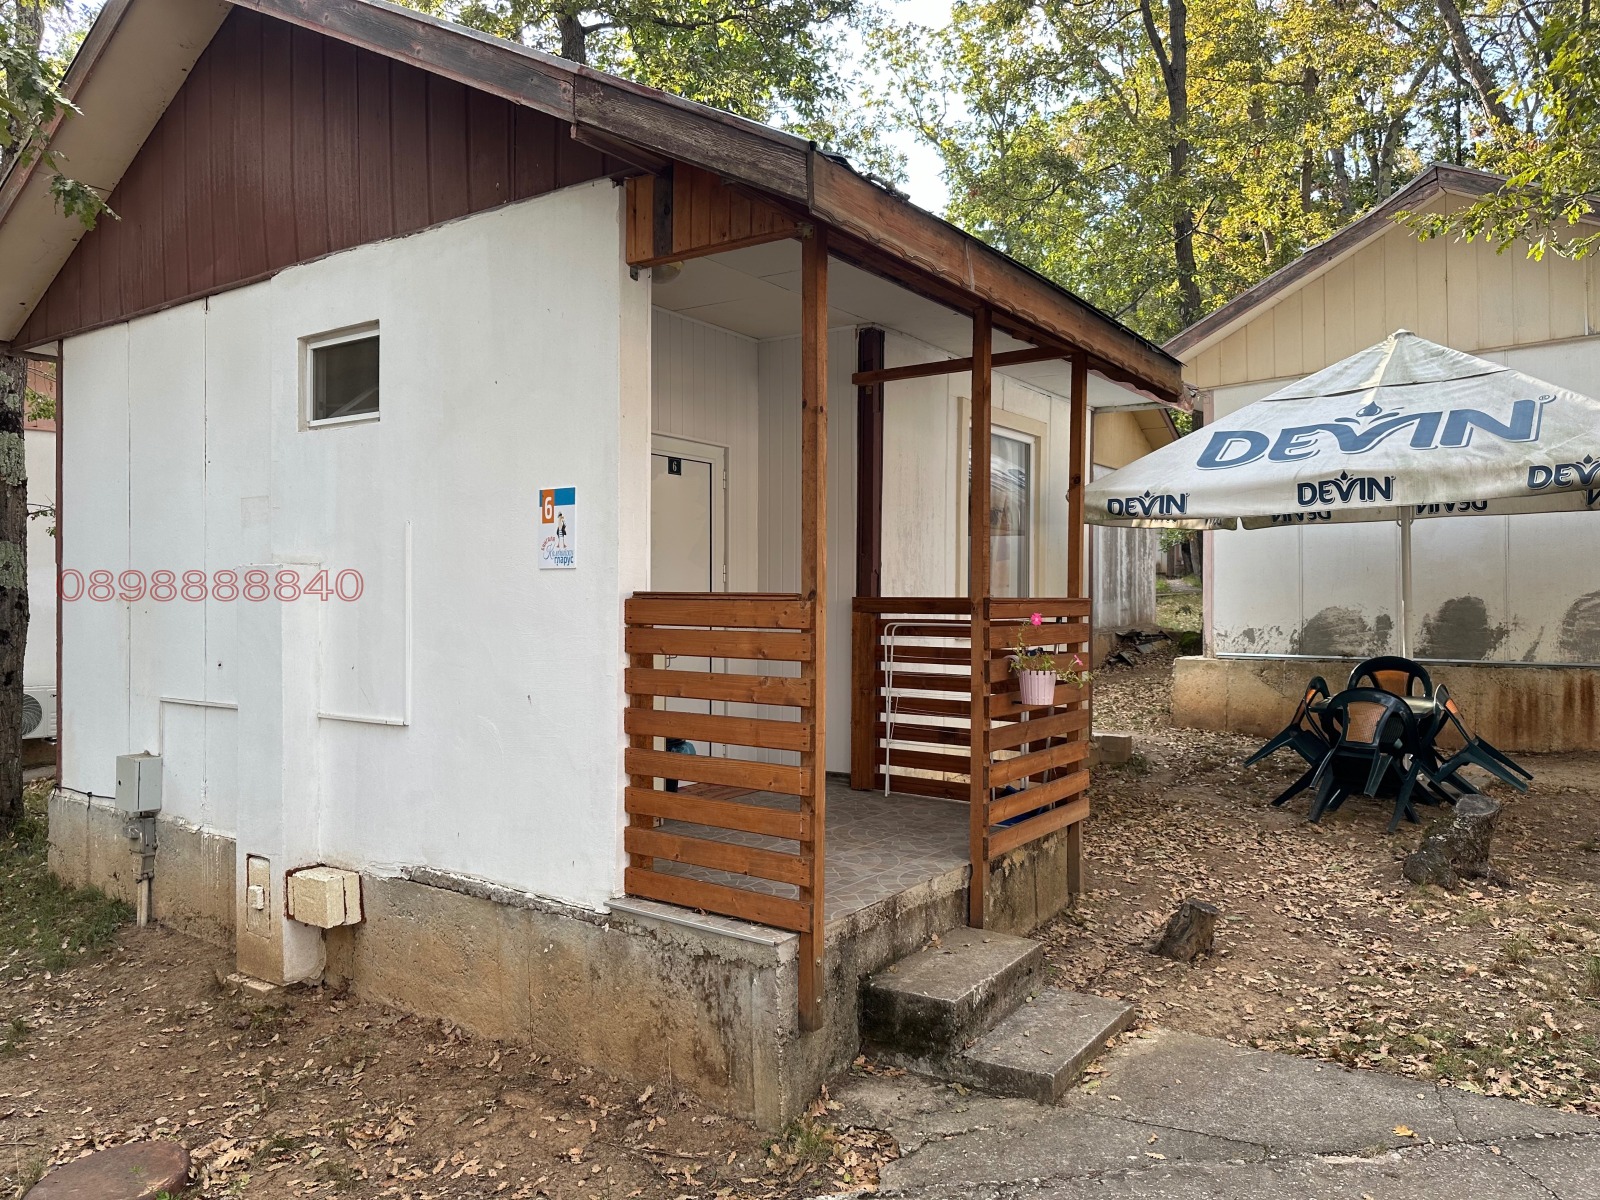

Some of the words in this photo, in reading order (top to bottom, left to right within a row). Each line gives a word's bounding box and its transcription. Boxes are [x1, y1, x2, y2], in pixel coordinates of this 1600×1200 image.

[1196, 399, 1540, 470] DEVIN
[672, 460, 678, 472] 6
[1297, 476, 1393, 507] DEVIN
[544, 496, 553, 520] 6
[1107, 493, 1187, 517] DEVIN
